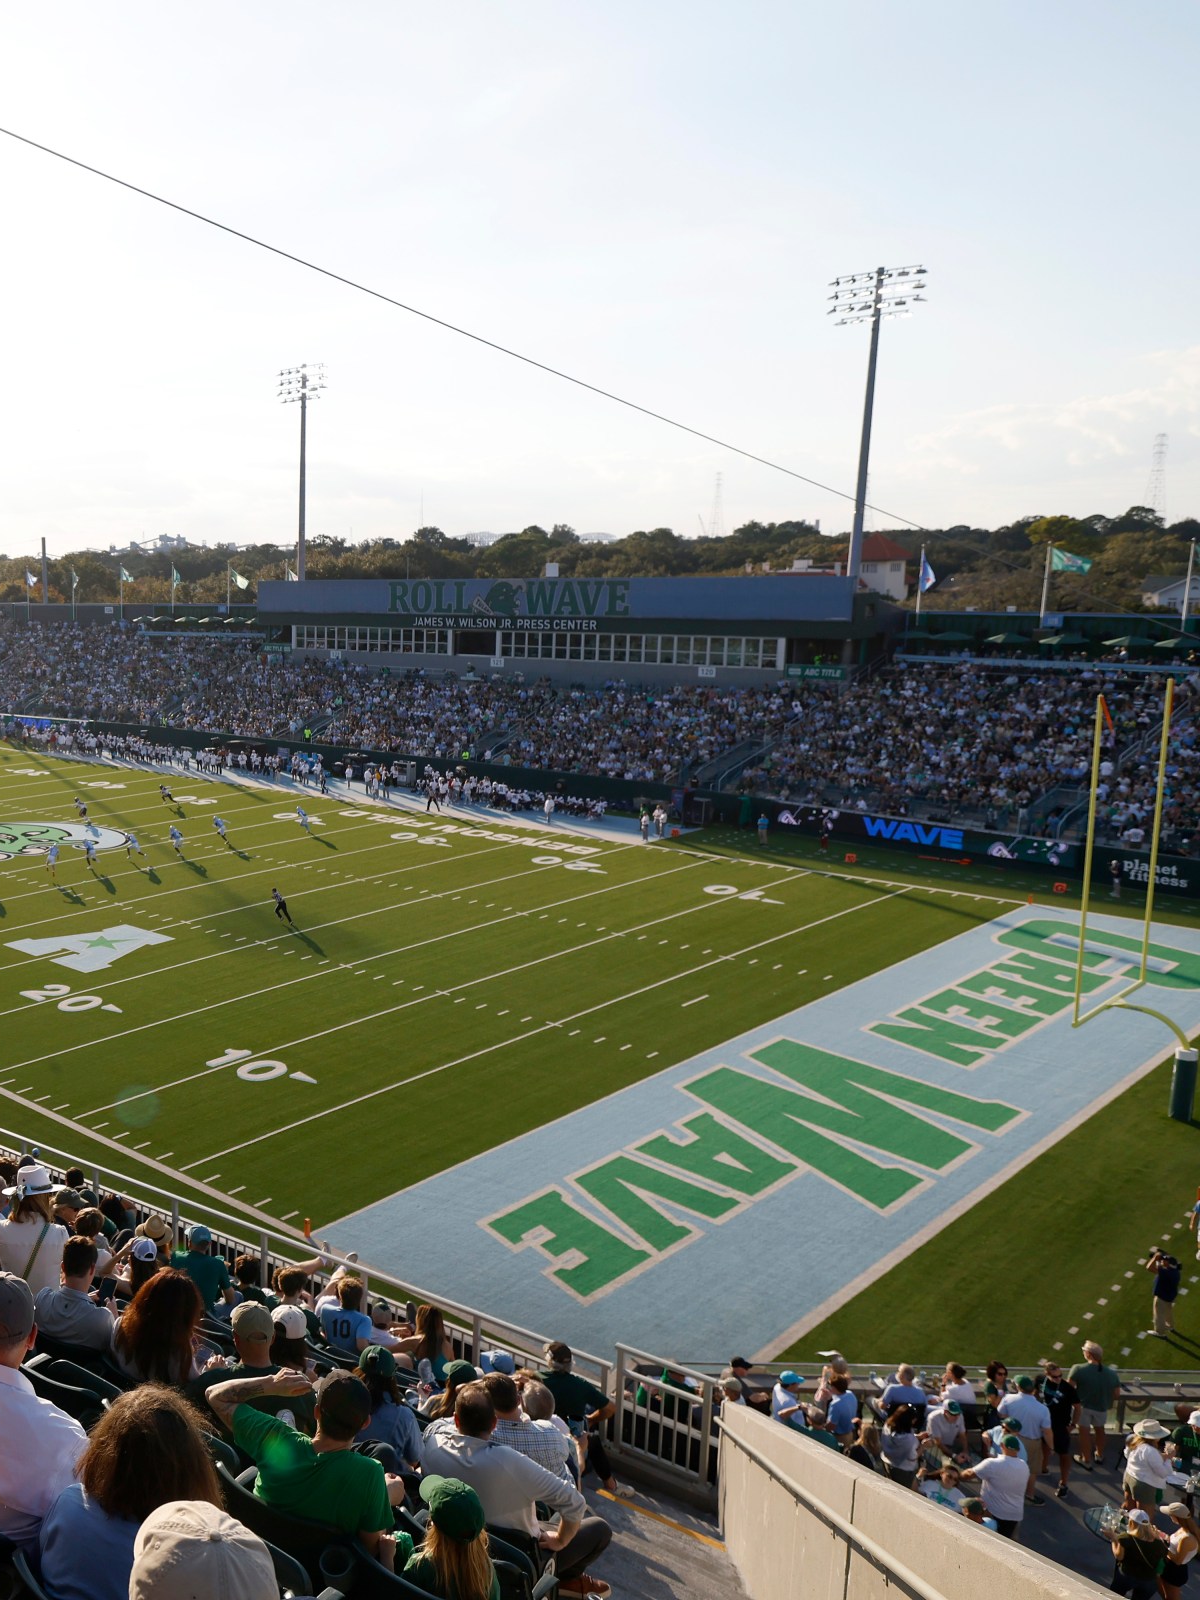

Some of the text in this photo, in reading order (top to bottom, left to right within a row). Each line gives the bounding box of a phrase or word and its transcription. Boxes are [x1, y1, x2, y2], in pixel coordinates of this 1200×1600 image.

[387, 580, 630, 616] ROLL WAVE
[413, 617, 597, 630] JAMES W. WILSON JR. PRESS CENTER
[804, 668, 819, 676] ABC
[821, 669, 842, 678] TITLE
[338, 810, 602, 854] BENSON FIELD
[390, 832, 447, 845] 30
[863, 816, 964, 850] WAVE
[531, 855, 602, 872] 20
[703, 884, 765, 900] 10
[19, 984, 103, 1013] 20
[205, 1048, 288, 1083] 10
[477, 917, 1200, 1308] GREEN WAVE
[332, 1318, 351, 1339] 10
